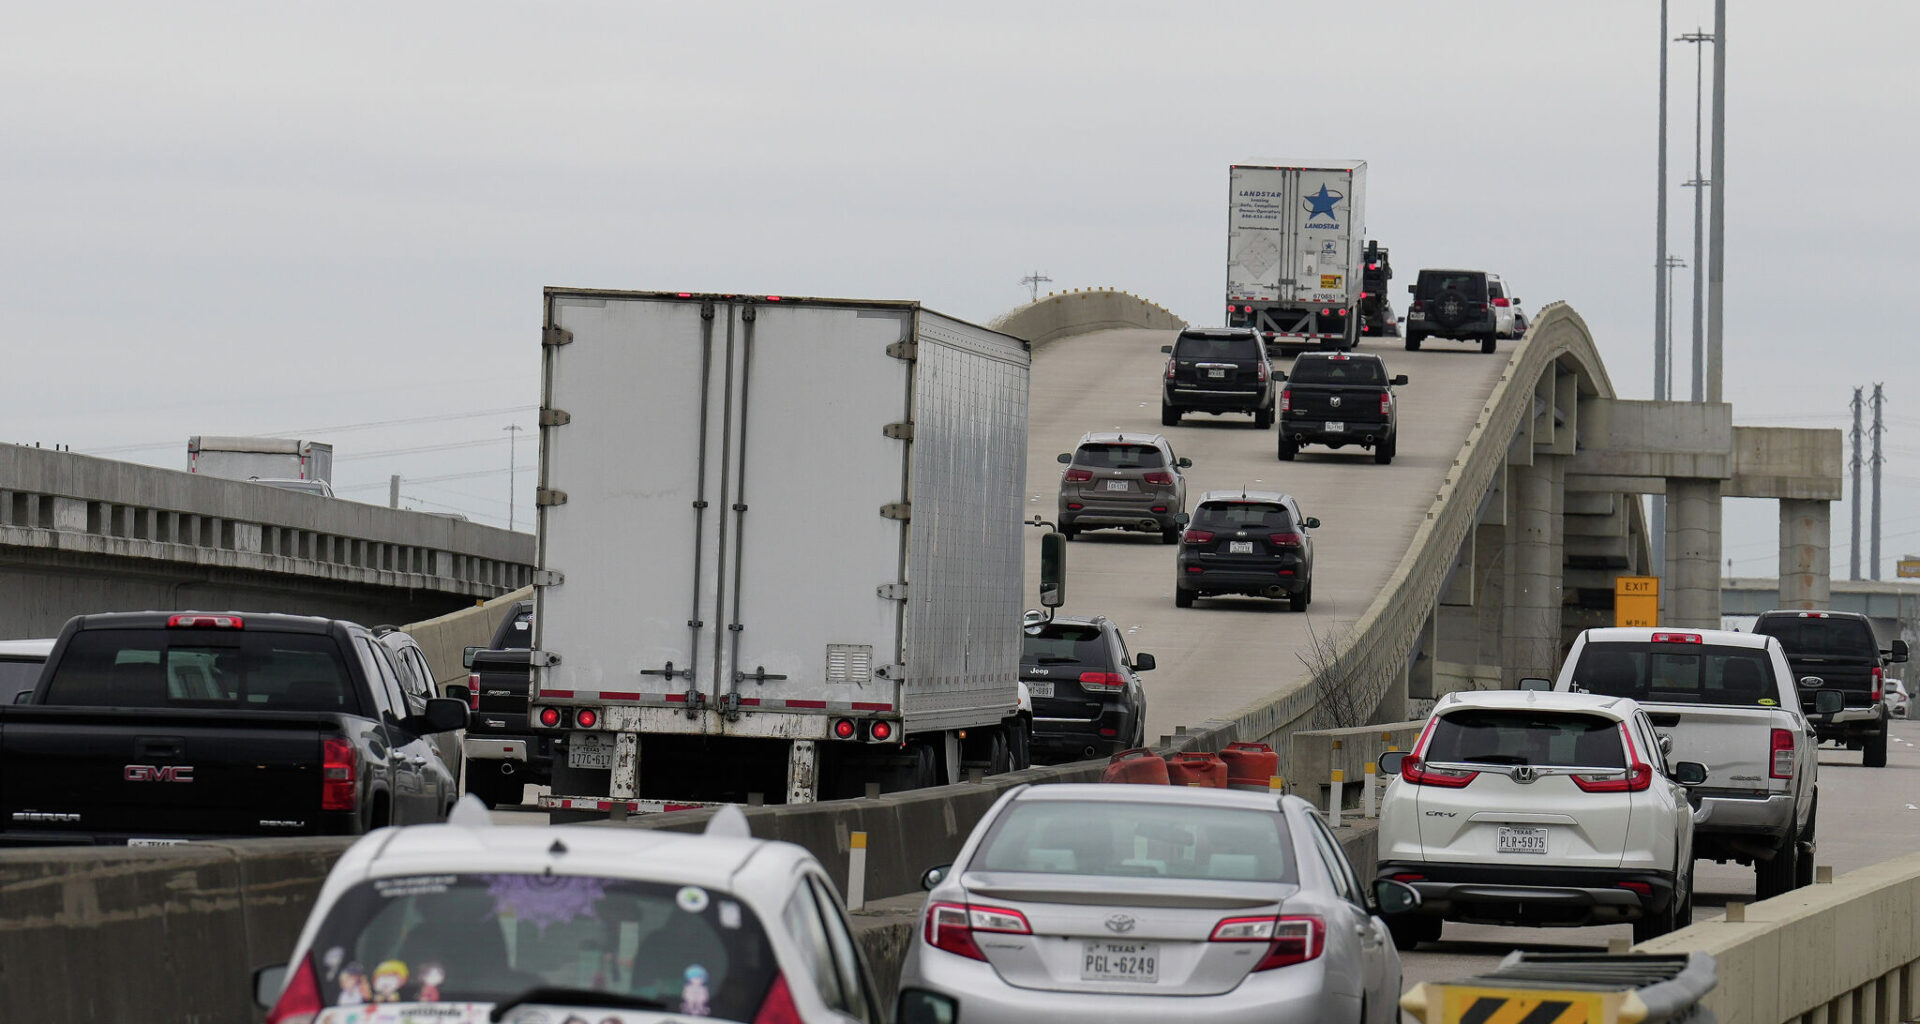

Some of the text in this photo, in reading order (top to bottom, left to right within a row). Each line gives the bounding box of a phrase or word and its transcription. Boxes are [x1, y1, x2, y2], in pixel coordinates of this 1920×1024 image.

[1239, 190, 1282, 198] LANDSTAR
[1625, 582, 1649, 591] EXIT
[1030, 667, 1049, 675] Jeep
[124, 765, 194, 782] GMC
[12, 812, 81, 821] SIERRA
[1425, 810, 1458, 818] CR-V
[1107, 944, 1136, 954] TEXAS
